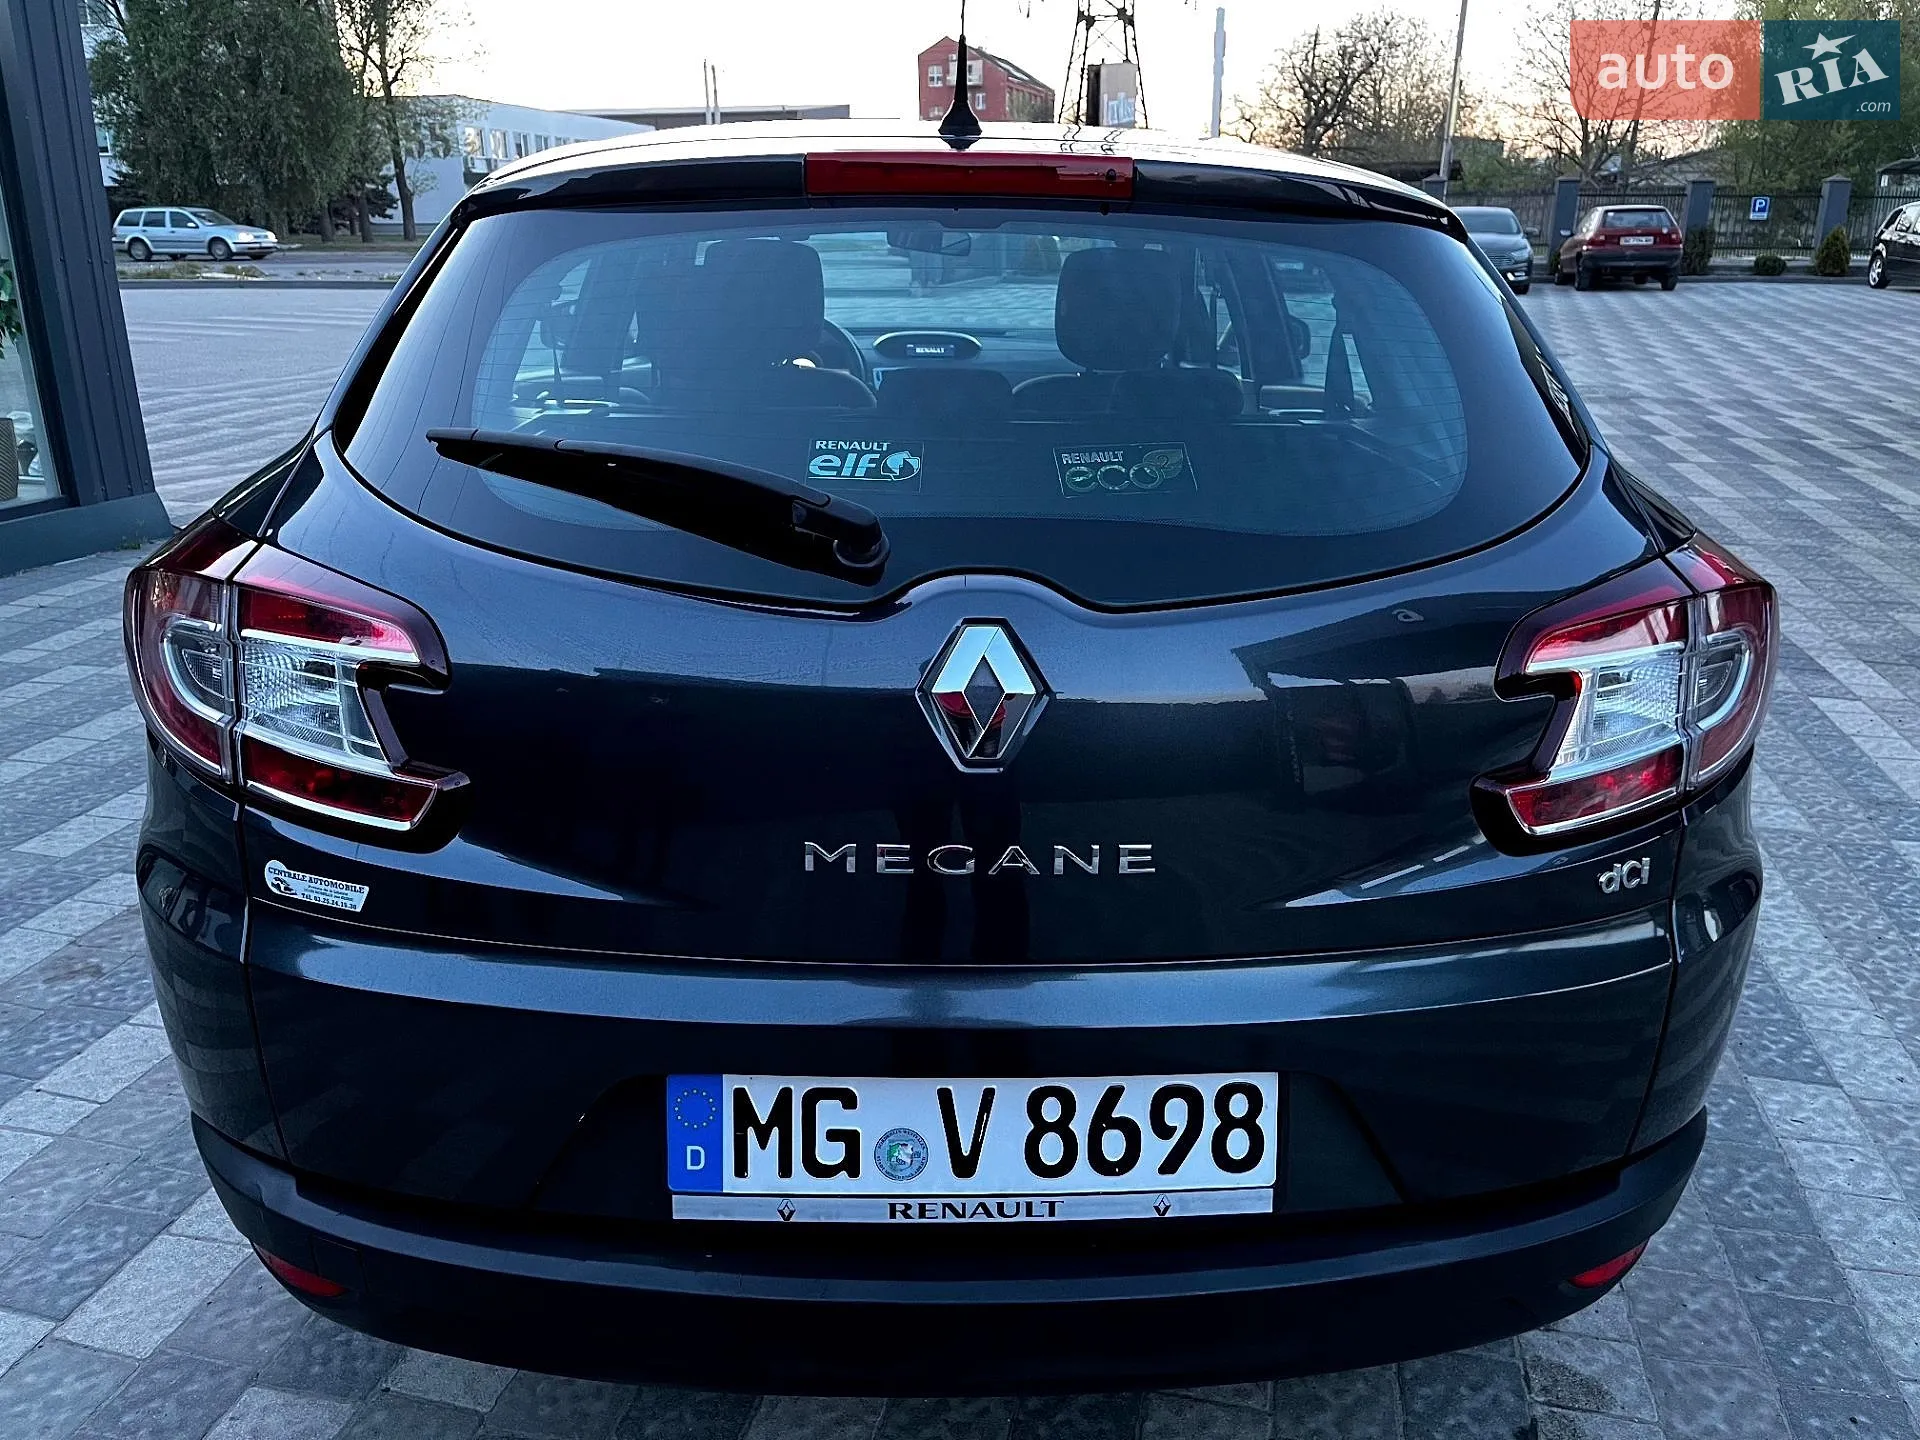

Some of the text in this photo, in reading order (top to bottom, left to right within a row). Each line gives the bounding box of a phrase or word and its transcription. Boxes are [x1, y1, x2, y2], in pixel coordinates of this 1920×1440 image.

[1755, 199, 1766, 211] P
[815, 440, 891, 451] RENAULT
[1061, 451, 1124, 464] RENAULT
[808, 453, 881, 477] elf
[804, 842, 1156, 875] MEGANE
[268, 867, 307, 882] CENTRALE
[308, 876, 364, 894] AUTOMOBILE
[733, 1081, 1265, 1180] MG V 8698
[686, 1146, 706, 1170] D
[887, 1201, 1065, 1220] RENAULT
